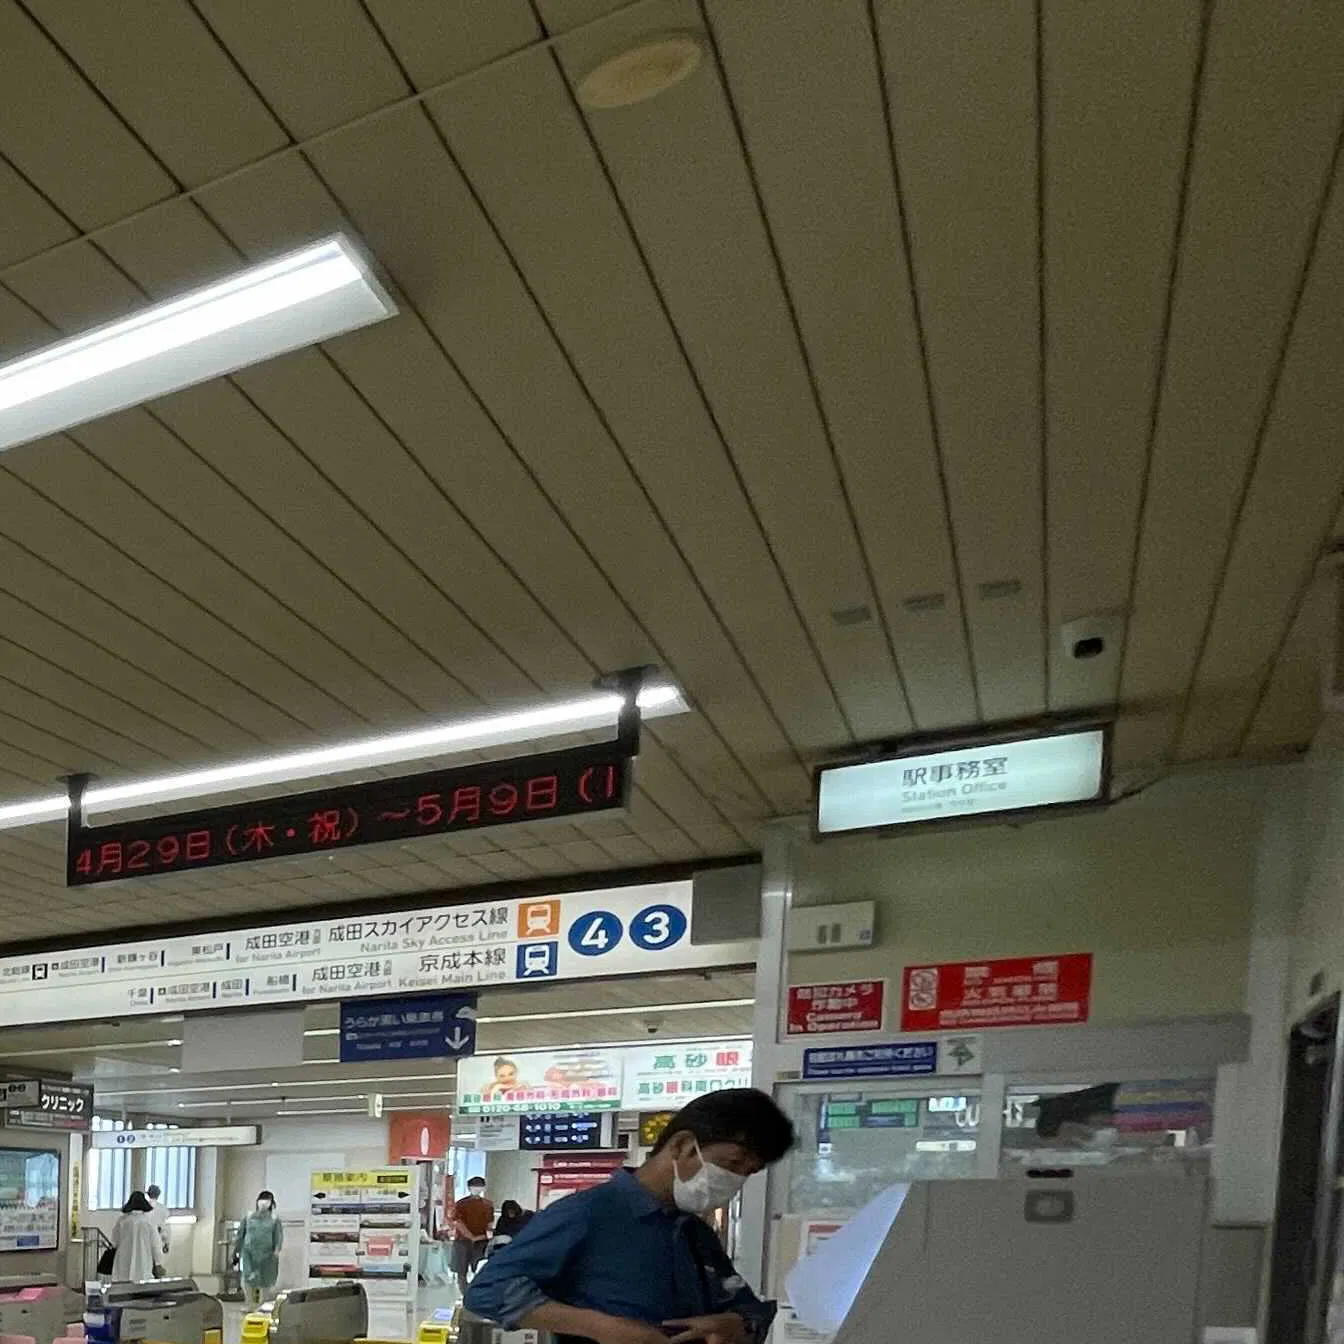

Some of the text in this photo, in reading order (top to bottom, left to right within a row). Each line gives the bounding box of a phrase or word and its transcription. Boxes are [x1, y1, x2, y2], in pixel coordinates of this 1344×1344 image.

[902, 757, 1008, 787] 駅事務室
[901, 781, 1007, 802] Station Office
[245, 930, 310, 951] 成田空港
[328, 906, 510, 943] 成田スカイアクセス線
[249, 950, 283, 962] Narita
[285, 947, 321, 960] Airport
[360, 940, 400, 953] Narita
[403, 938, 426, 952] Sky
[429, 932, 476, 947] Access
[479, 928, 509, 942] Line
[311, 961, 381, 982] 成田空港
[418, 947, 507, 973] 京成本線
[315, 981, 352, 994] Narita
[354, 979, 393, 992] Airport
[398, 974, 438, 988] Keisei
[441, 971, 474, 985] Main
[477, 968, 506, 982] Line
[652, 1051, 752, 1071] 高砂眼
[41, 1094, 84, 1113] クリニック
